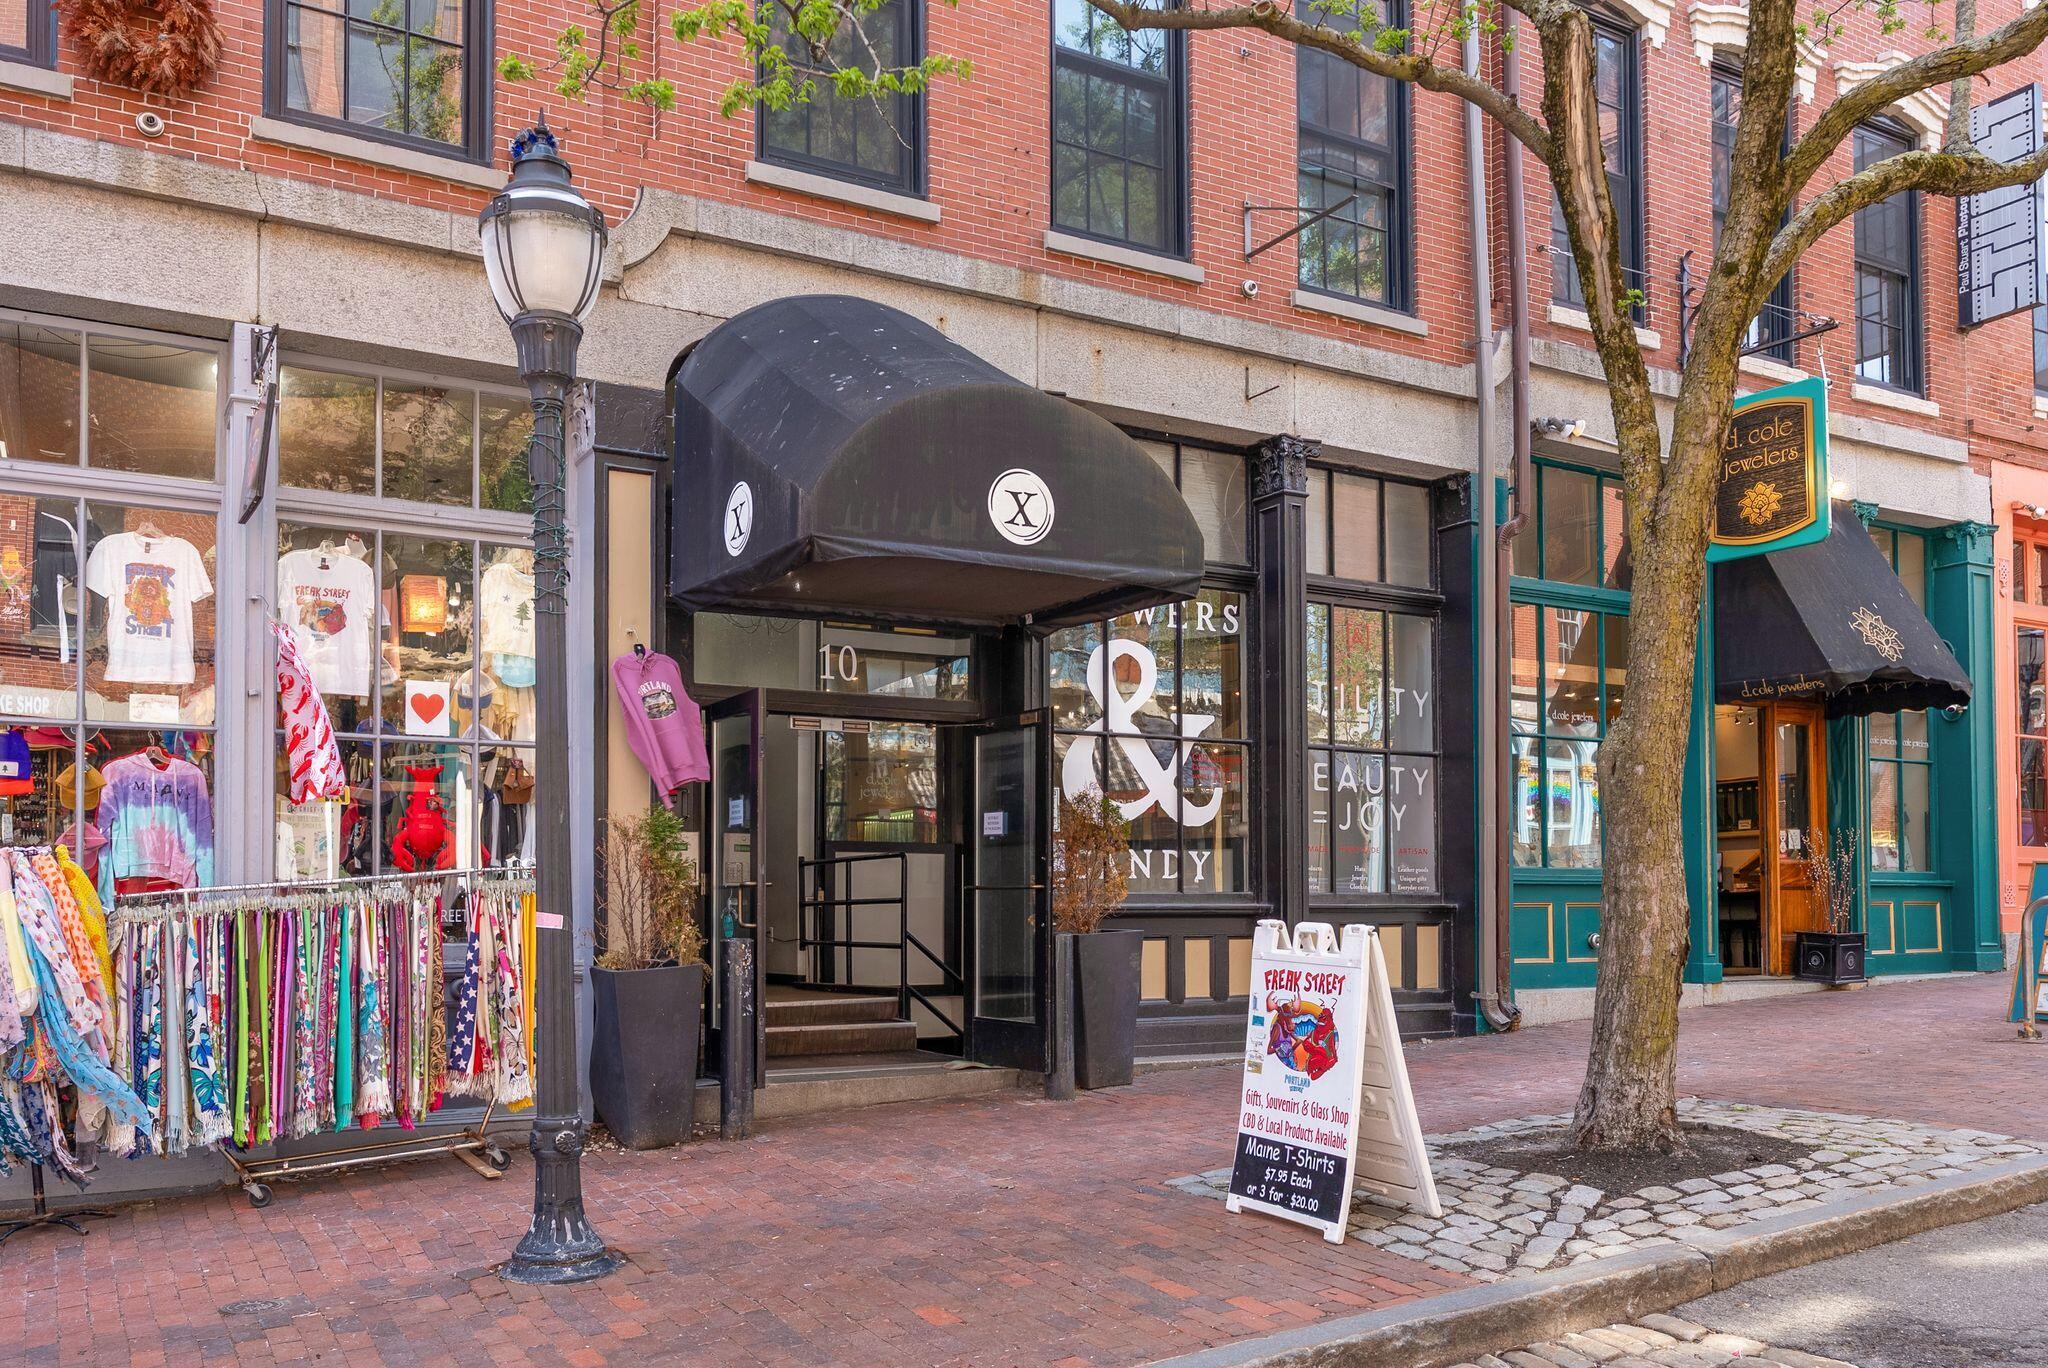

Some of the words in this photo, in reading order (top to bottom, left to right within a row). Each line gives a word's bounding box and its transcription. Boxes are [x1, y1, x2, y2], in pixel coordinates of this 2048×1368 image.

[1957, 194, 1969, 238] Photog
[1958, 238, 1969, 271] Stuart
[1958, 272, 1969, 294] Paul
[1748, 417, 1793, 444] cole
[1721, 446, 1799, 482] jewelers
[730, 500, 746, 541] X
[1004, 489, 1038, 528] X
[295, 585, 321, 600] FREAK
[322, 588, 351, 599] STREET
[1107, 601, 1239, 634] WERS
[819, 643, 858, 682] 10
[638, 680, 672, 696] ORTLAND
[1741, 678, 1774, 698] d.cole
[1777, 673, 1825, 697] jewelers
[16, 694, 50, 714] SHOP
[1310, 681, 1429, 718] TILITY
[1571, 712, 1594, 724] jewelers
[1062, 638, 1224, 827] &
[1313, 762, 1429, 796] EAUTY
[1338, 801, 1407, 832] JOY
[1397, 847, 1429, 856] ARTISAN
[1397, 865, 1415, 873] Leather
[1399, 875, 1417, 884] Unique
[1349, 883, 1368, 891] Clothin
[1397, 884, 1417, 892] Everyday
[441, 909, 467, 923] REET
[1264, 969, 1302, 993] FREAK
[1304, 971, 1347, 996] STREET
[1284, 1074, 1311, 1088] PORTLAND
[1246, 1089, 1264, 1110] Gifts,
[1266, 1093, 1300, 1115] Souvenirs
[1301, 1099, 1309, 1116] &
[1311, 1101, 1329, 1121] Glass
[1331, 1105, 1349, 1128] Shop
[1243, 1112, 1256, 1129] CBD
[1257, 1115, 1265, 1131] &
[1266, 1117, 1283, 1136] Local
[1284, 1119, 1314, 1143] Products
[1315, 1128, 1348, 1151] Available
[1245, 1136, 1280, 1161] Maine
[1284, 1145, 1336, 1175] T-Shirts
[1264, 1166, 1288, 1182] $7.95
[1290, 1171, 1312, 1190] Each
[1246, 1184, 1257, 1195] or
[1259, 1184, 1266, 1198] 3
[1269, 1186, 1284, 1203] for
[1290, 1192, 1319, 1212] $20.00
